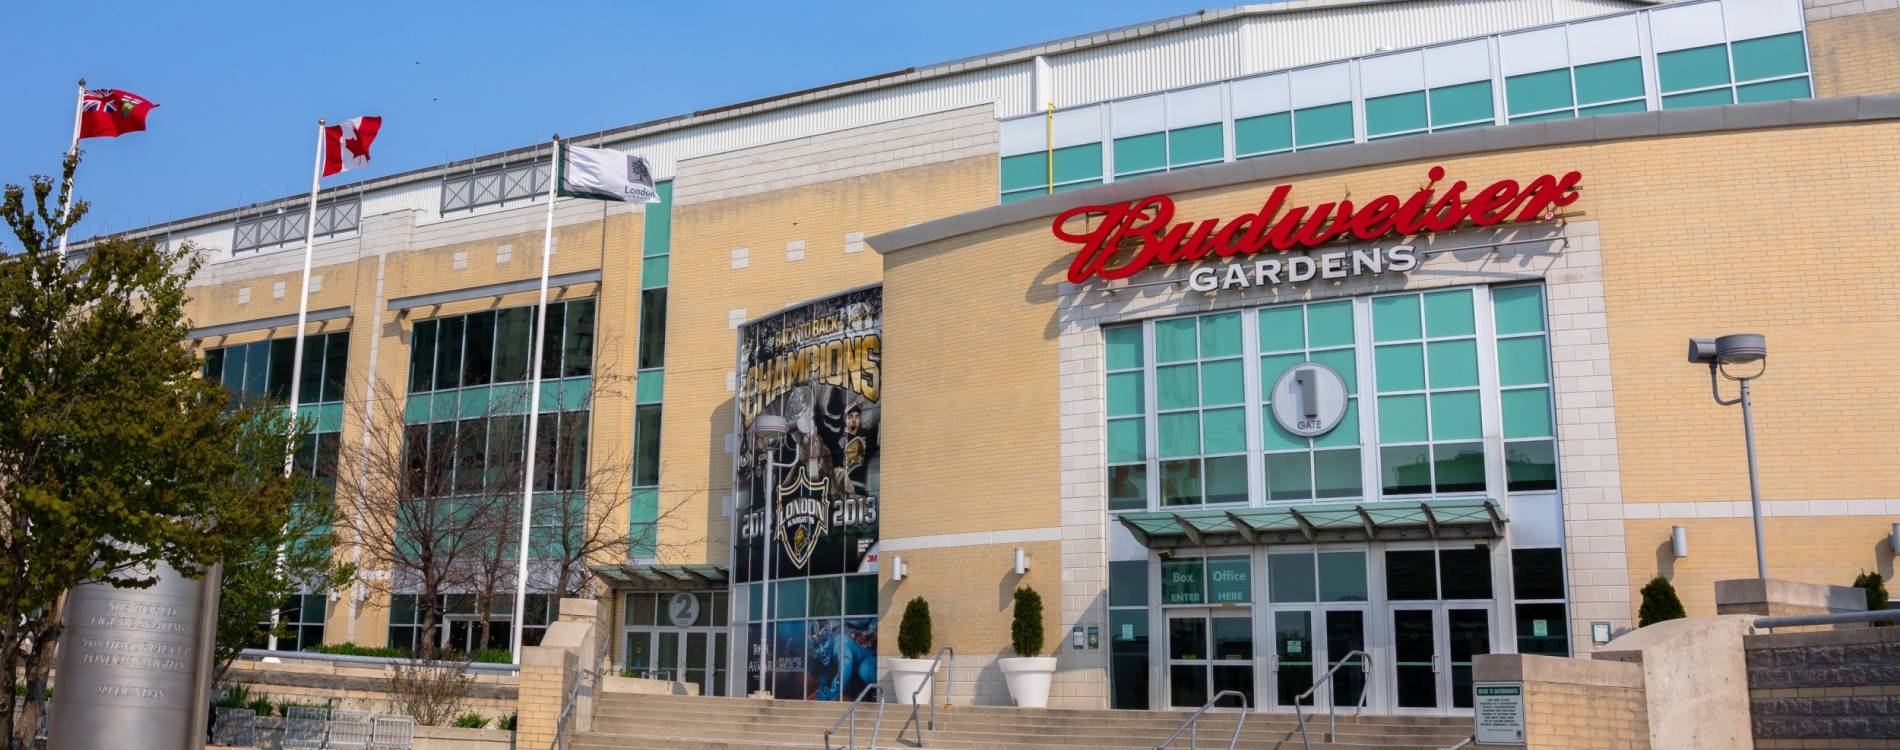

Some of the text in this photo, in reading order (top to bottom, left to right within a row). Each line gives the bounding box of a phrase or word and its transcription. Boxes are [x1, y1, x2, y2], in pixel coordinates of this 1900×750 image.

[624, 185, 655, 197] London
[1051, 165, 1583, 285] Budweiser
[1188, 244, 1419, 293] GARDENS
[775, 315, 838, 347] BACK TO BACK
[740, 334, 881, 430] CHAMPIONS
[1294, 368, 1318, 419] 1
[1297, 419, 1322, 430] GATE
[742, 495, 878, 540] 201 2013
[779, 498, 827, 528] LONDON
[787, 515, 815, 528] KNIGHTS
[1172, 570, 1247, 583] Box Office
[675, 593, 692, 619] 2
[1171, 591, 1244, 602] ENTER HERE
